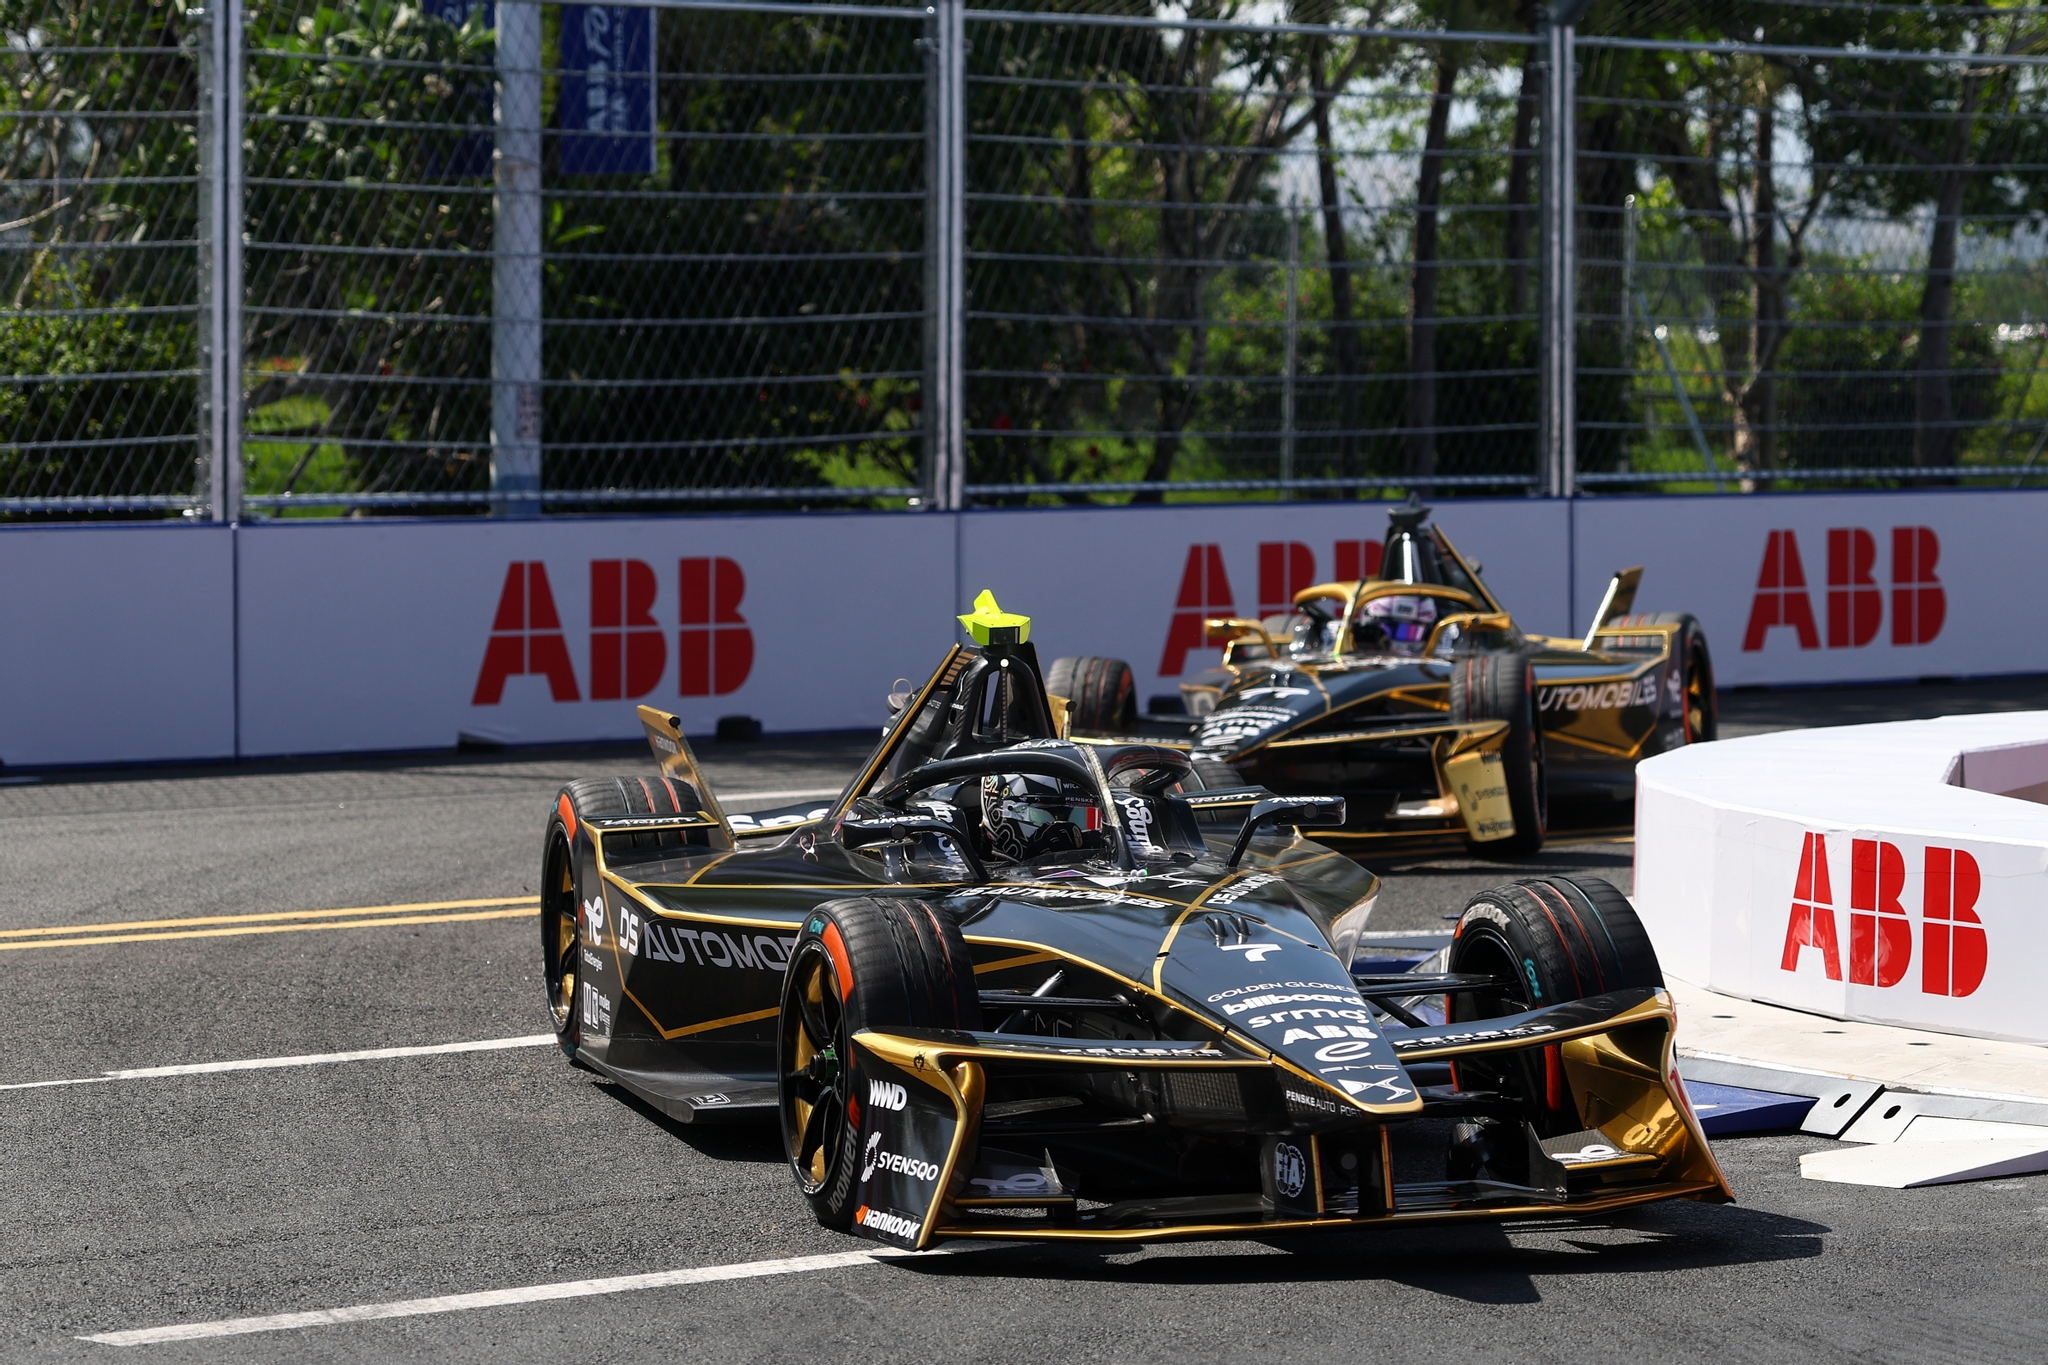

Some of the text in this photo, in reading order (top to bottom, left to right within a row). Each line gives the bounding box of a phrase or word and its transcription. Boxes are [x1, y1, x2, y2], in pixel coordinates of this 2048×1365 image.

[1743, 526, 1946, 653] ABB
[472, 557, 755, 706] ABB
[1539, 675, 1657, 711] UTOMOBILES
[1782, 832, 1987, 998] ABB
[620, 906, 639, 957] DS
[1220, 943, 1283, 962] 7
[1207, 982, 1283, 1003] GOLDEN
[1221, 994, 1367, 1016] billboard
[1282, 1025, 1379, 1046] ABB
[1286, 1089, 1316, 1107] PENSKE
[878, 1150, 940, 1181] SYENSQO
